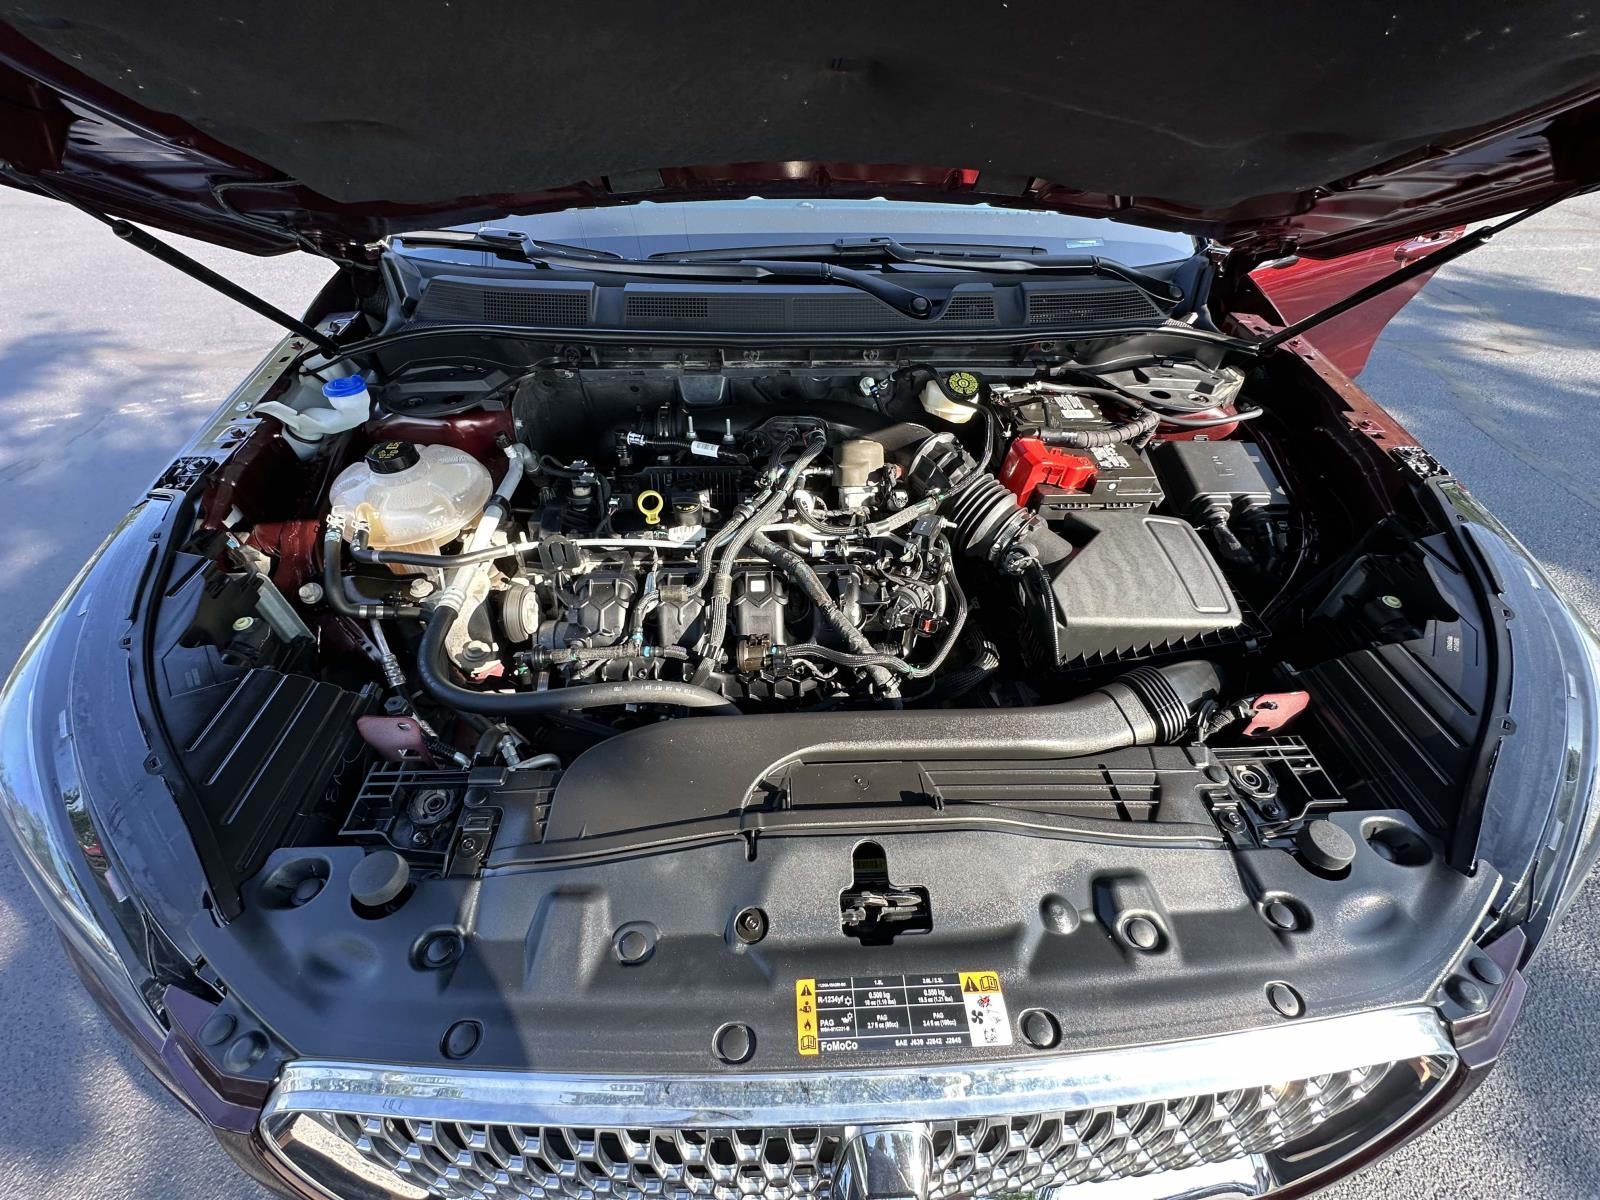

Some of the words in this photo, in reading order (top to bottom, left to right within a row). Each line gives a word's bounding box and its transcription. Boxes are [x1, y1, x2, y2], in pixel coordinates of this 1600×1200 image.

[868, 991, 883, 999] 0.500
[883, 991, 891, 1000] kg
[938, 988, 945, 997] kg
[817, 995, 844, 1004] R-1234yf
[821, 1040, 858, 1051] FoMoCo
[910, 1038, 924, 1046] J639
